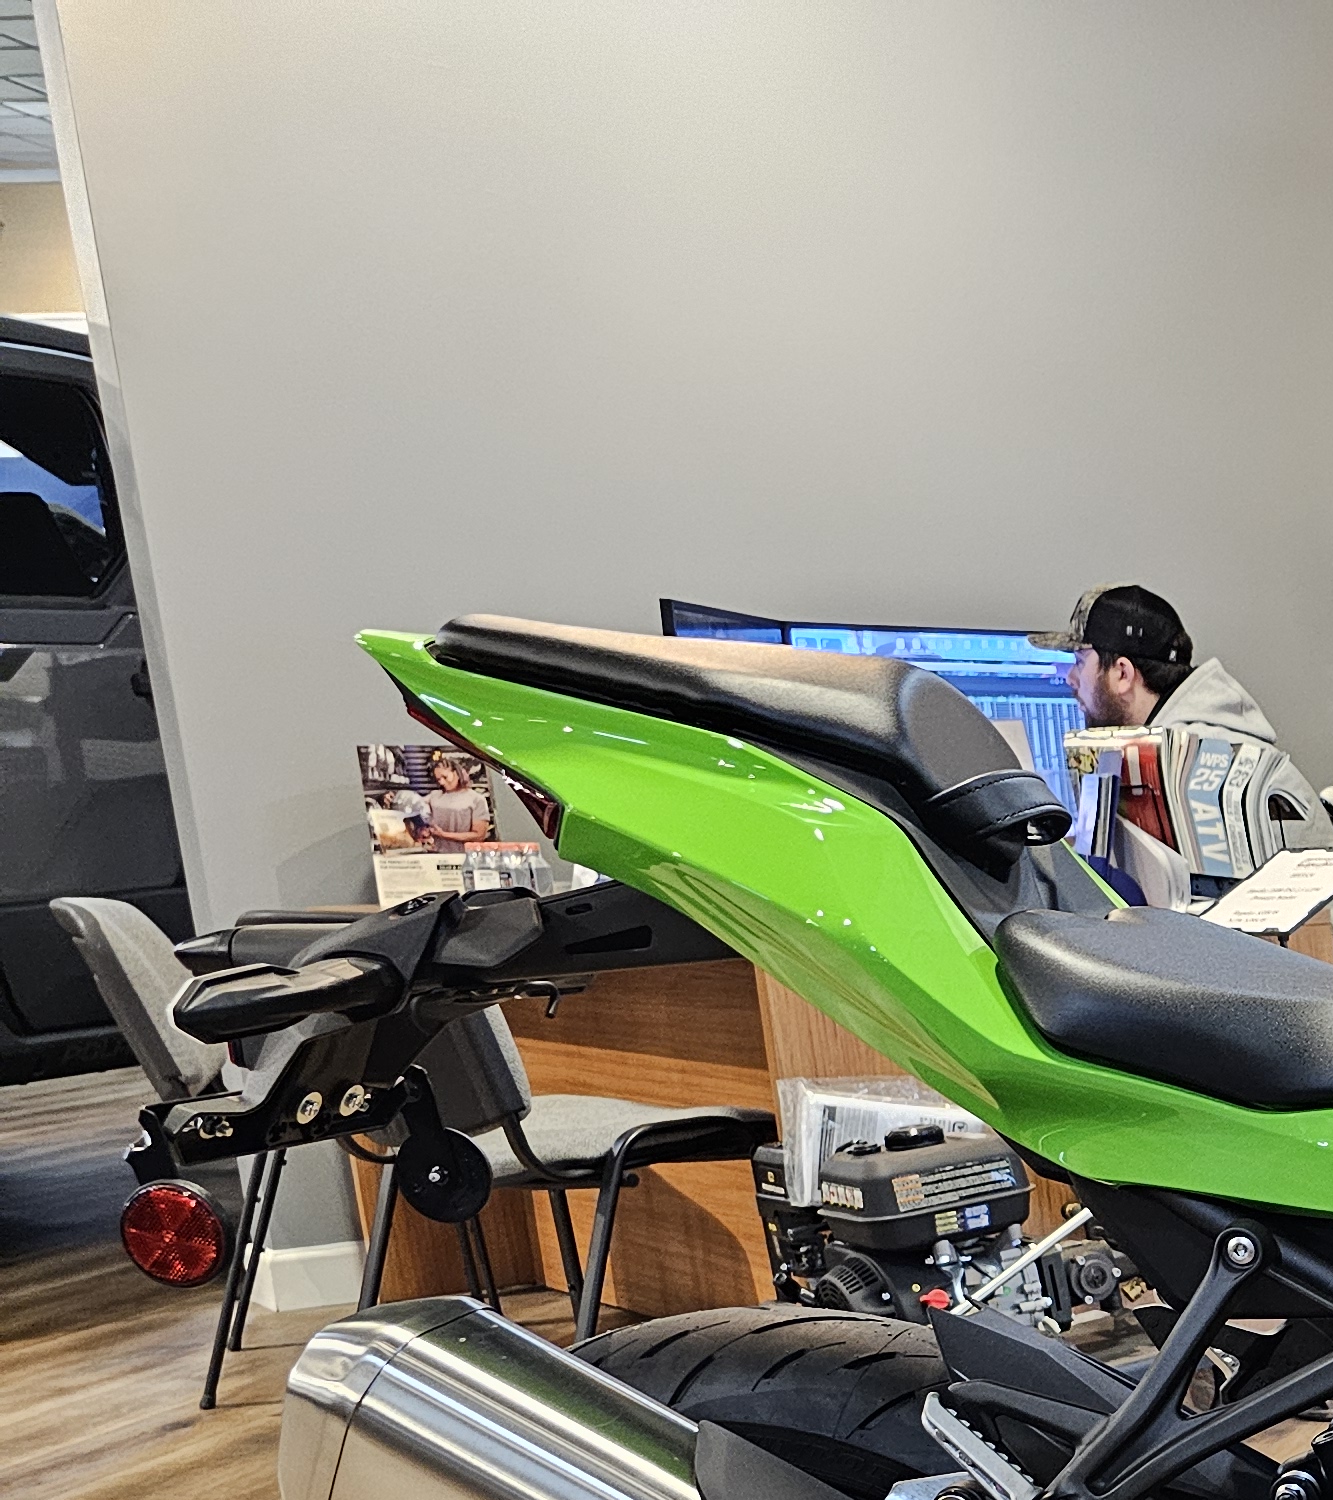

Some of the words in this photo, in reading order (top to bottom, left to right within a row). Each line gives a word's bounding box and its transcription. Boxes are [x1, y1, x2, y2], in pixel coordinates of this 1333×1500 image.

[1200, 751, 1230, 768] WPS
[1187, 768, 1227, 792] 25
[1189, 799, 1231, 864] ATV
